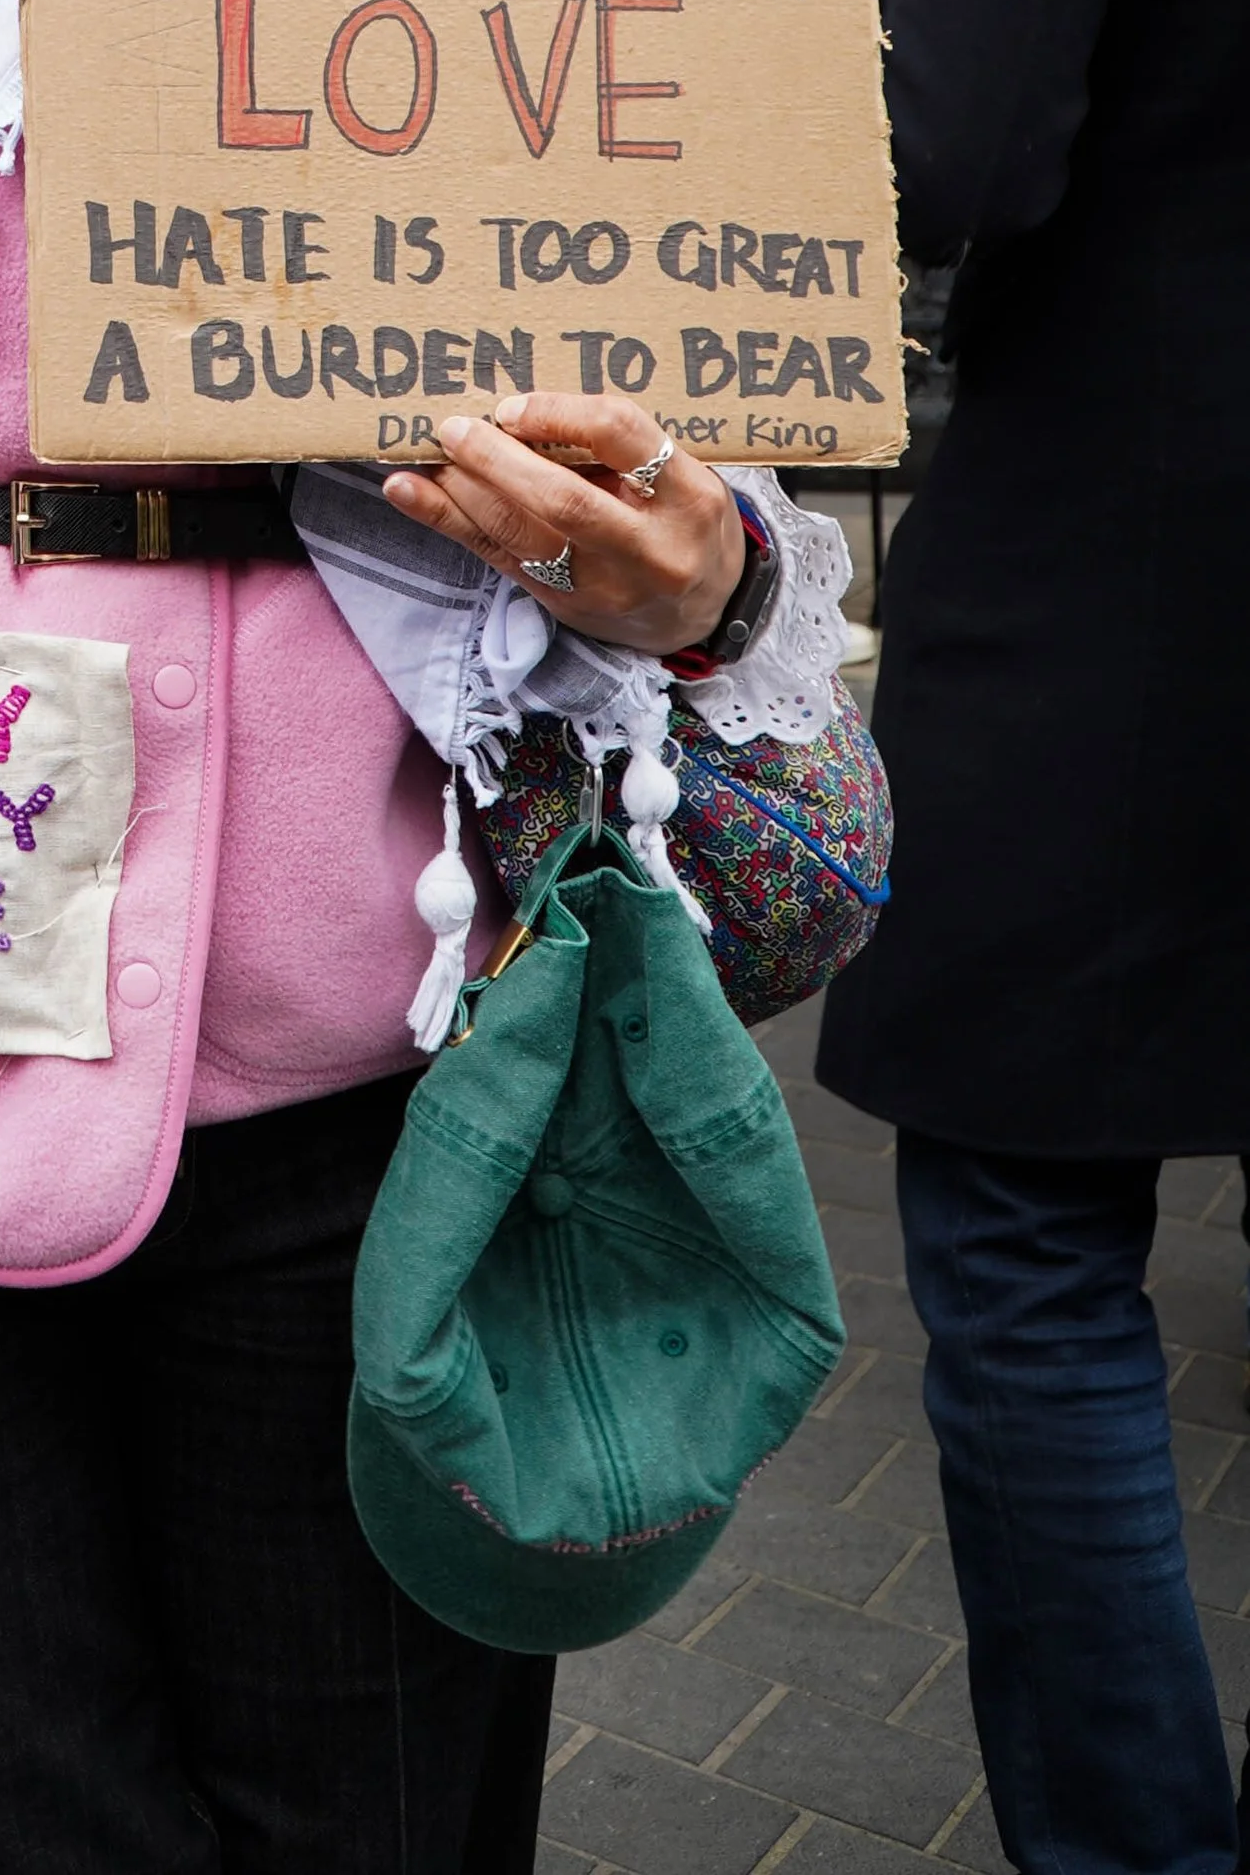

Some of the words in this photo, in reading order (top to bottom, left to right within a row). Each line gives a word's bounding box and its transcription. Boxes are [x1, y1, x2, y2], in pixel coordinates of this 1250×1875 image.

[85, 200, 331, 290] HATE
[373, 215, 445, 285] IS
[480, 216, 631, 292] TOO
[656, 220, 865, 300] GREAT
[83, 320, 150, 405] A
[190, 319, 533, 403] BURDEN
[561, 327, 657, 397] TO
[682, 327, 885, 404] BEAR
[746, 413, 839, 456] King
